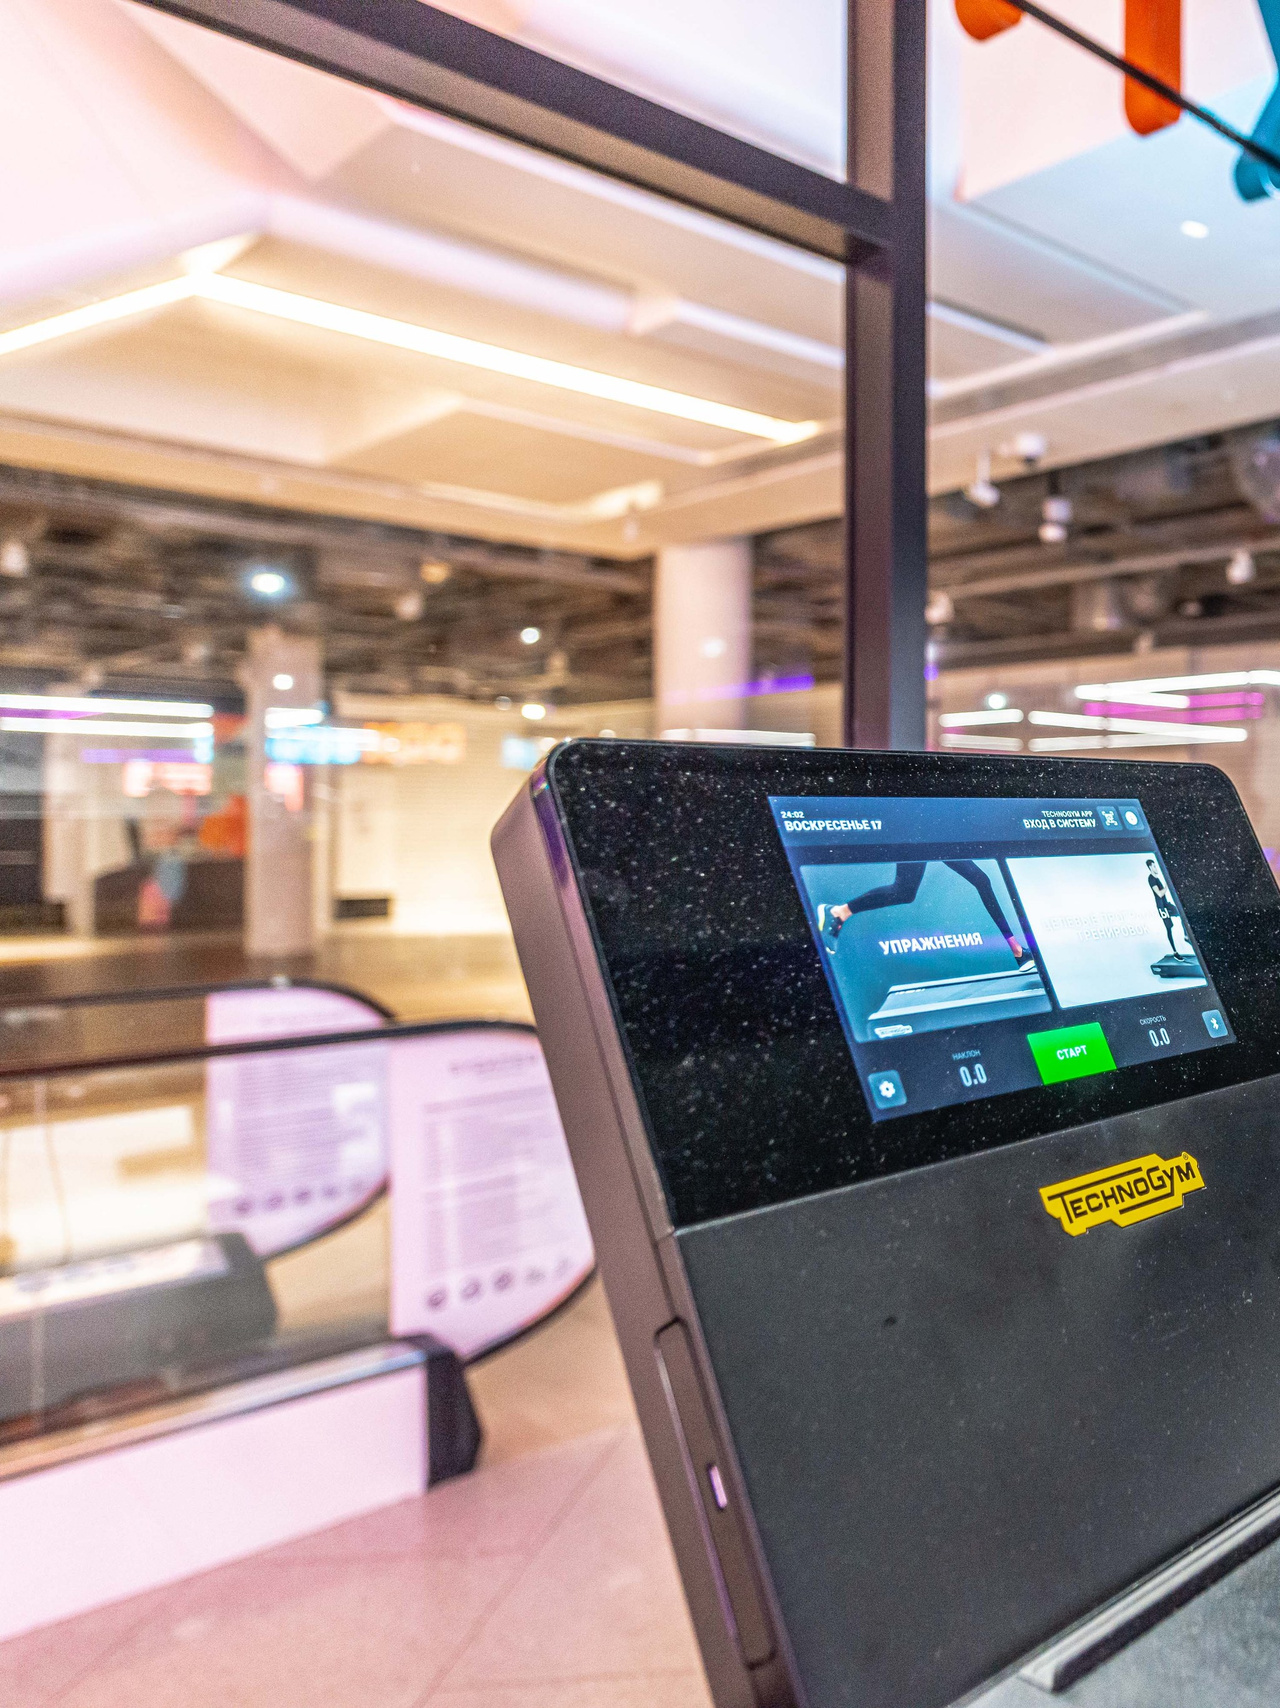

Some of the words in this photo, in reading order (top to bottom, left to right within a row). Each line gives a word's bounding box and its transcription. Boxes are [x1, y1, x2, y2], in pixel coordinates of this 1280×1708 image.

[780, 811, 805, 819] 24:02
[1041, 810, 1080, 818] TECHNOGYM
[784, 819, 869, 831] ВОСКРЕСЕНЬЕ
[870, 820, 882, 830] 17
[1023, 819, 1050, 829] ВХОД
[1050, 819, 1056, 828] В
[1056, 818, 1096, 828] СИСТЕМУ
[878, 932, 983, 956] УПРАЖНЕНИЯ
[1139, 1015, 1167, 1026] СКОРОСТЬ
[1148, 1027, 1171, 1047] 0.0
[952, 1049, 981, 1061] НАКЛОН
[1056, 1045, 1087, 1060] СТАРТ
[959, 1063, 987, 1087] 0.0
